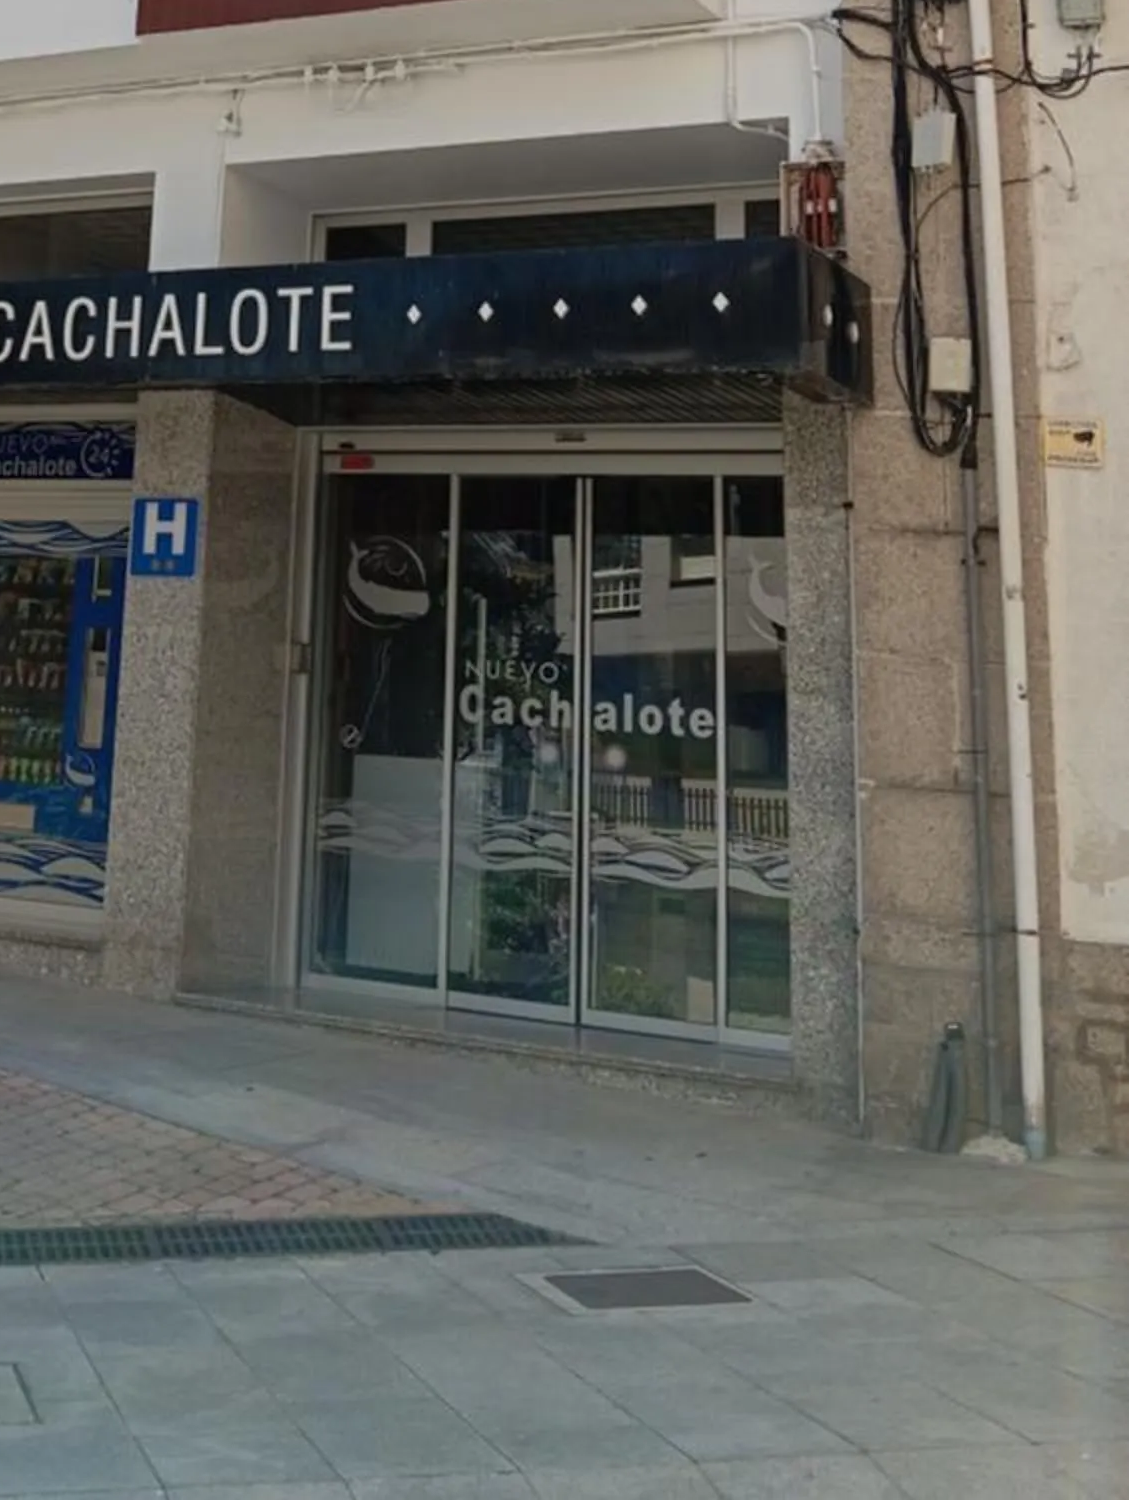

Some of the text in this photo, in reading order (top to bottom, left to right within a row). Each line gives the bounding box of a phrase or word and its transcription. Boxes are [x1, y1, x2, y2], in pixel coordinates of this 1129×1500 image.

[142, 501, 188, 555] H
[465, 659, 560, 685] NUEVO
[459, 682, 716, 739] Cachalote
